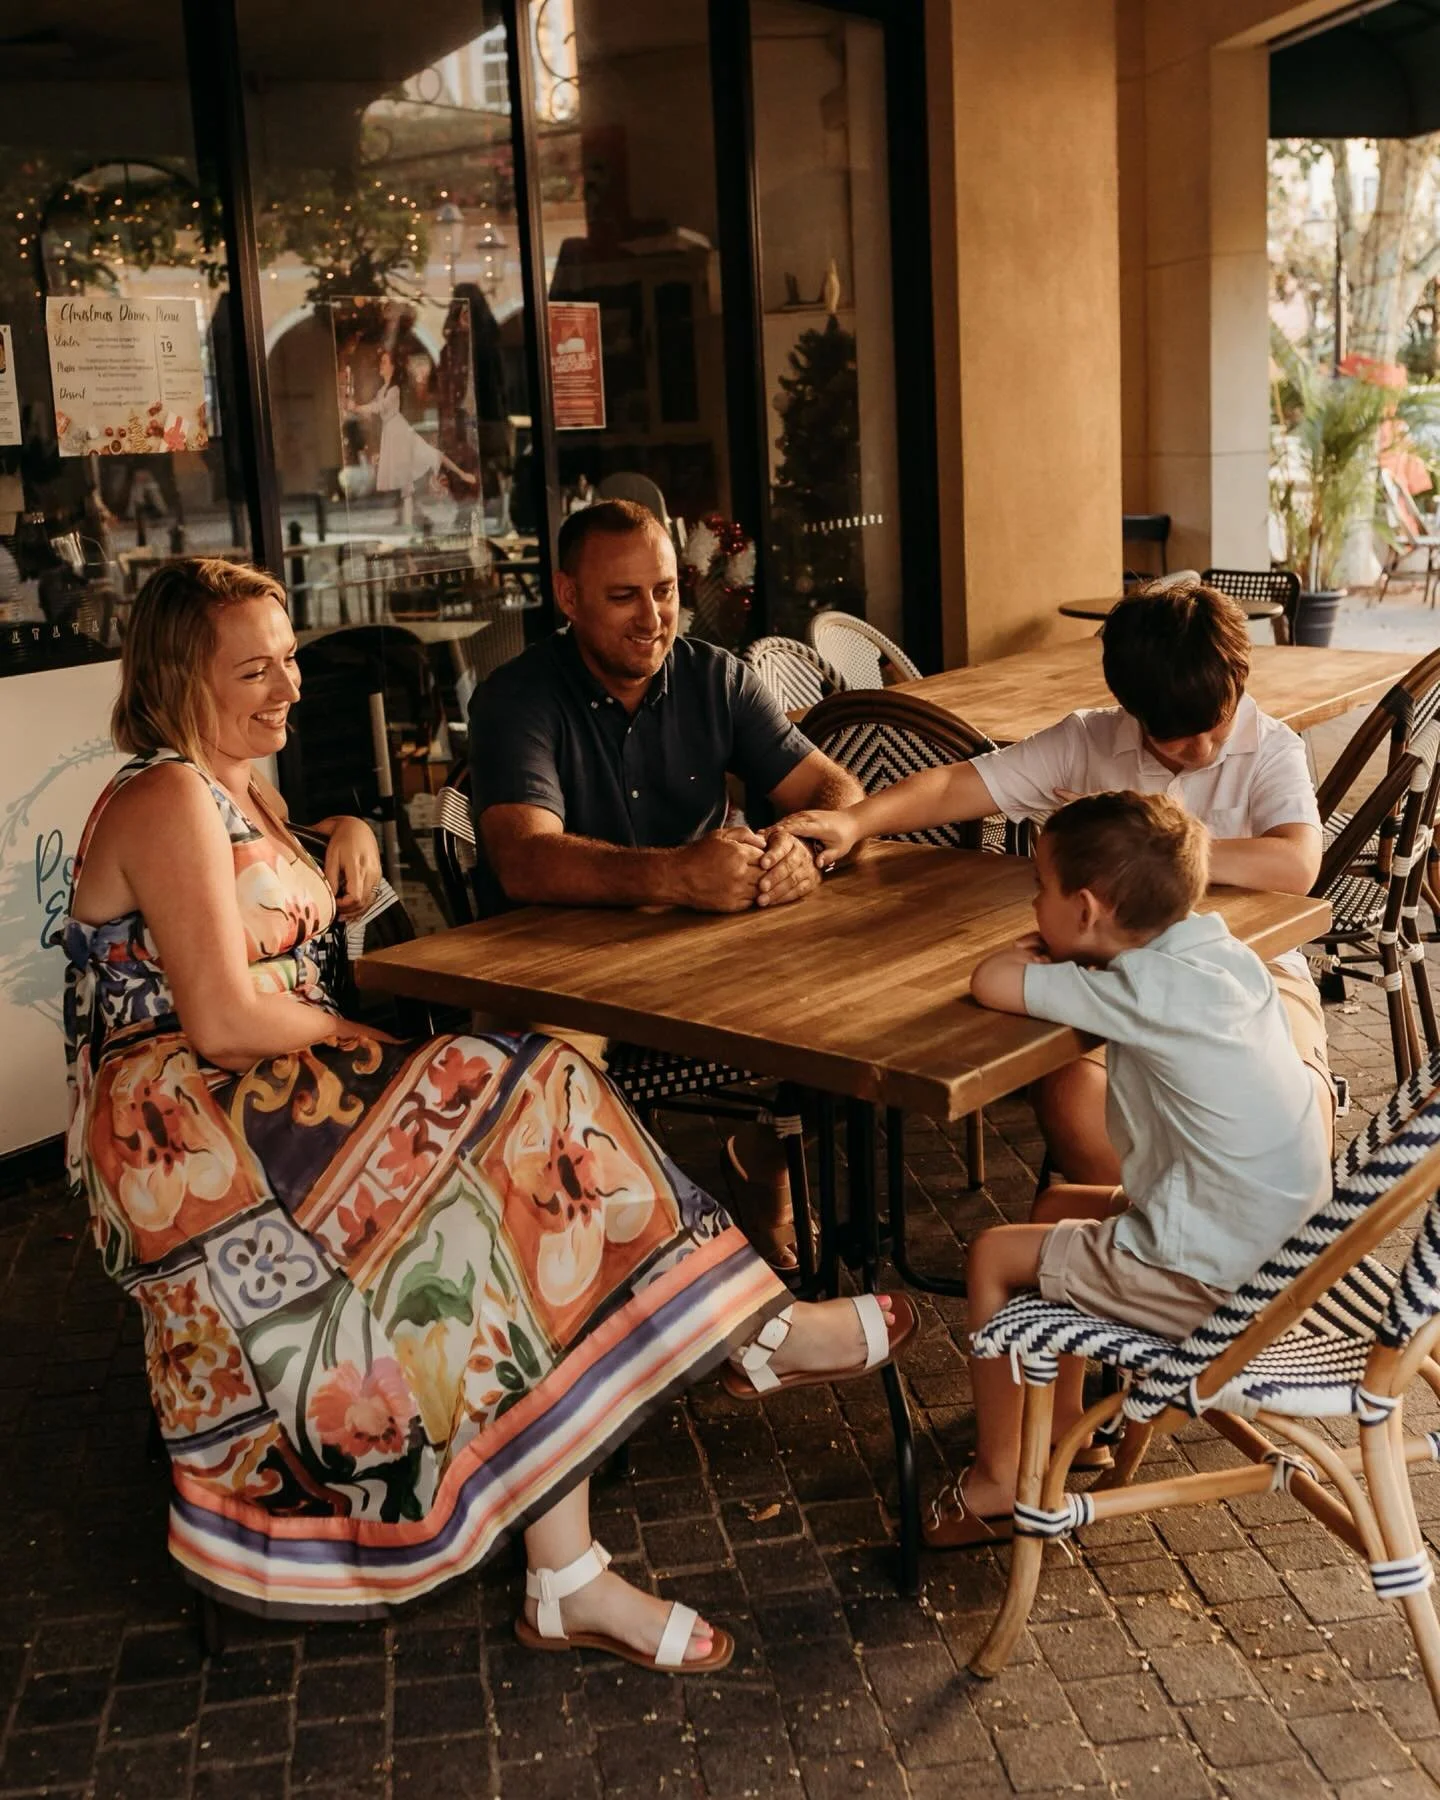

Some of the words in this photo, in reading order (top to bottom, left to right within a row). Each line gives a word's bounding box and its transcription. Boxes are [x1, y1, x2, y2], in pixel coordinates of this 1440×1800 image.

[60, 303, 113, 324] Christmas
[119, 303, 150, 322] Dinner
[156, 305, 181, 323] Menu
[160, 341, 173, 352] 19
[59, 387, 86, 400] Dessert
